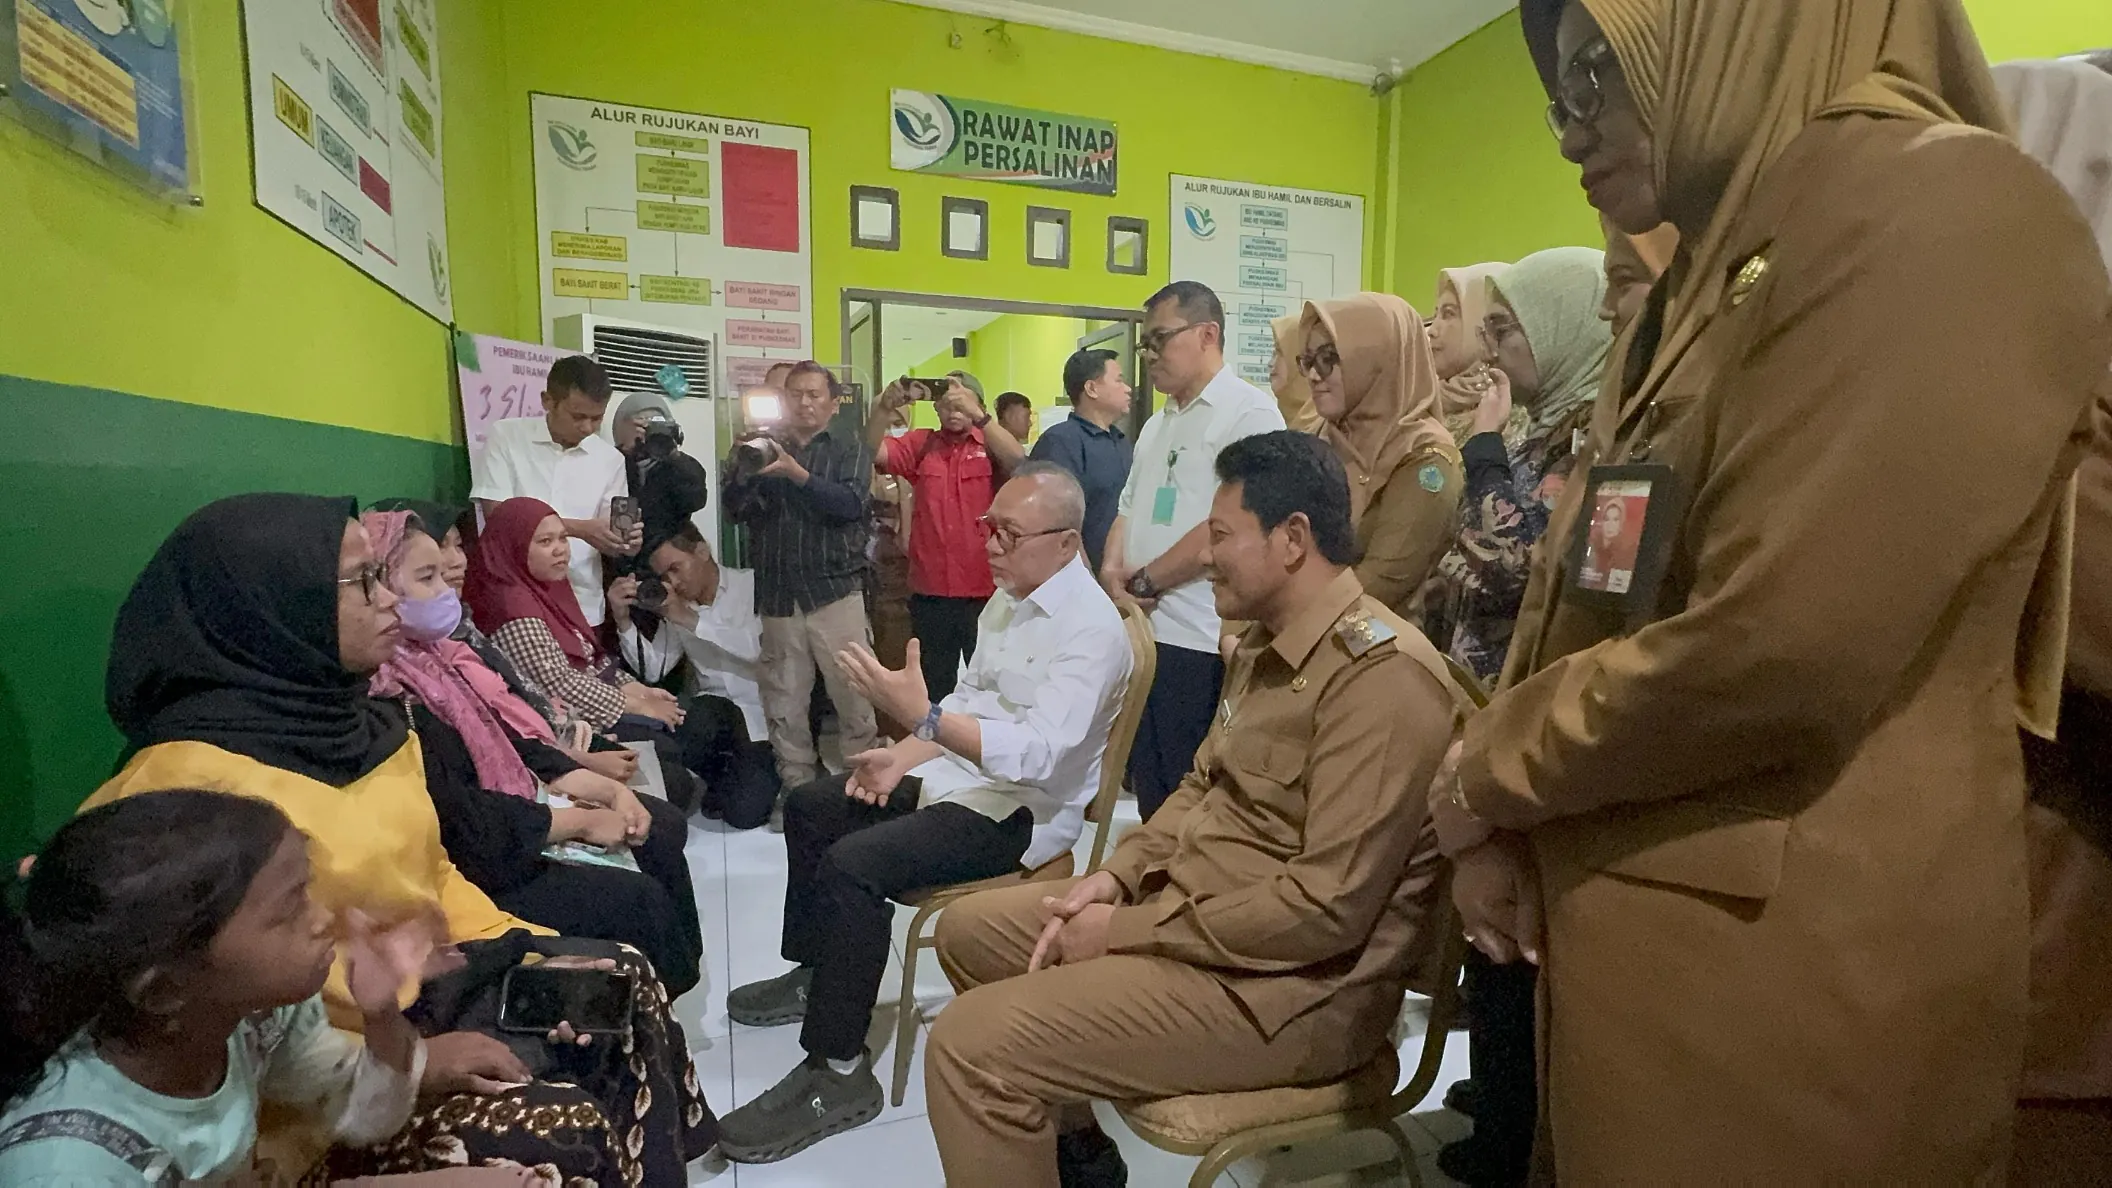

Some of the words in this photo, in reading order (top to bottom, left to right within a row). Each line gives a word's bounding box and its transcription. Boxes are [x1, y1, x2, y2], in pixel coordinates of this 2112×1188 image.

[591, 106, 637, 124] ALUR
[642, 113, 719, 135] RUJUKAN
[724, 123, 759, 140] BAYI
[963, 109, 1050, 147] RAWAT
[1057, 123, 1114, 154] INAP
[963, 140, 1114, 184] PERSALINAN
[1184, 181, 1209, 193] ALUR
[1210, 185, 1250, 198] RUJUKAN
[1251, 188, 1267, 200] IBU
[1268, 190, 1292, 203] HAMIL
[1294, 193, 1311, 205] DAN
[1313, 195, 1352, 209] BERSALIN
[599, 280, 622, 290] BERAT
[512, 364, 526, 376] IBU
[526, 366, 548, 378] HAMI
[839, 395, 854, 404] AN
